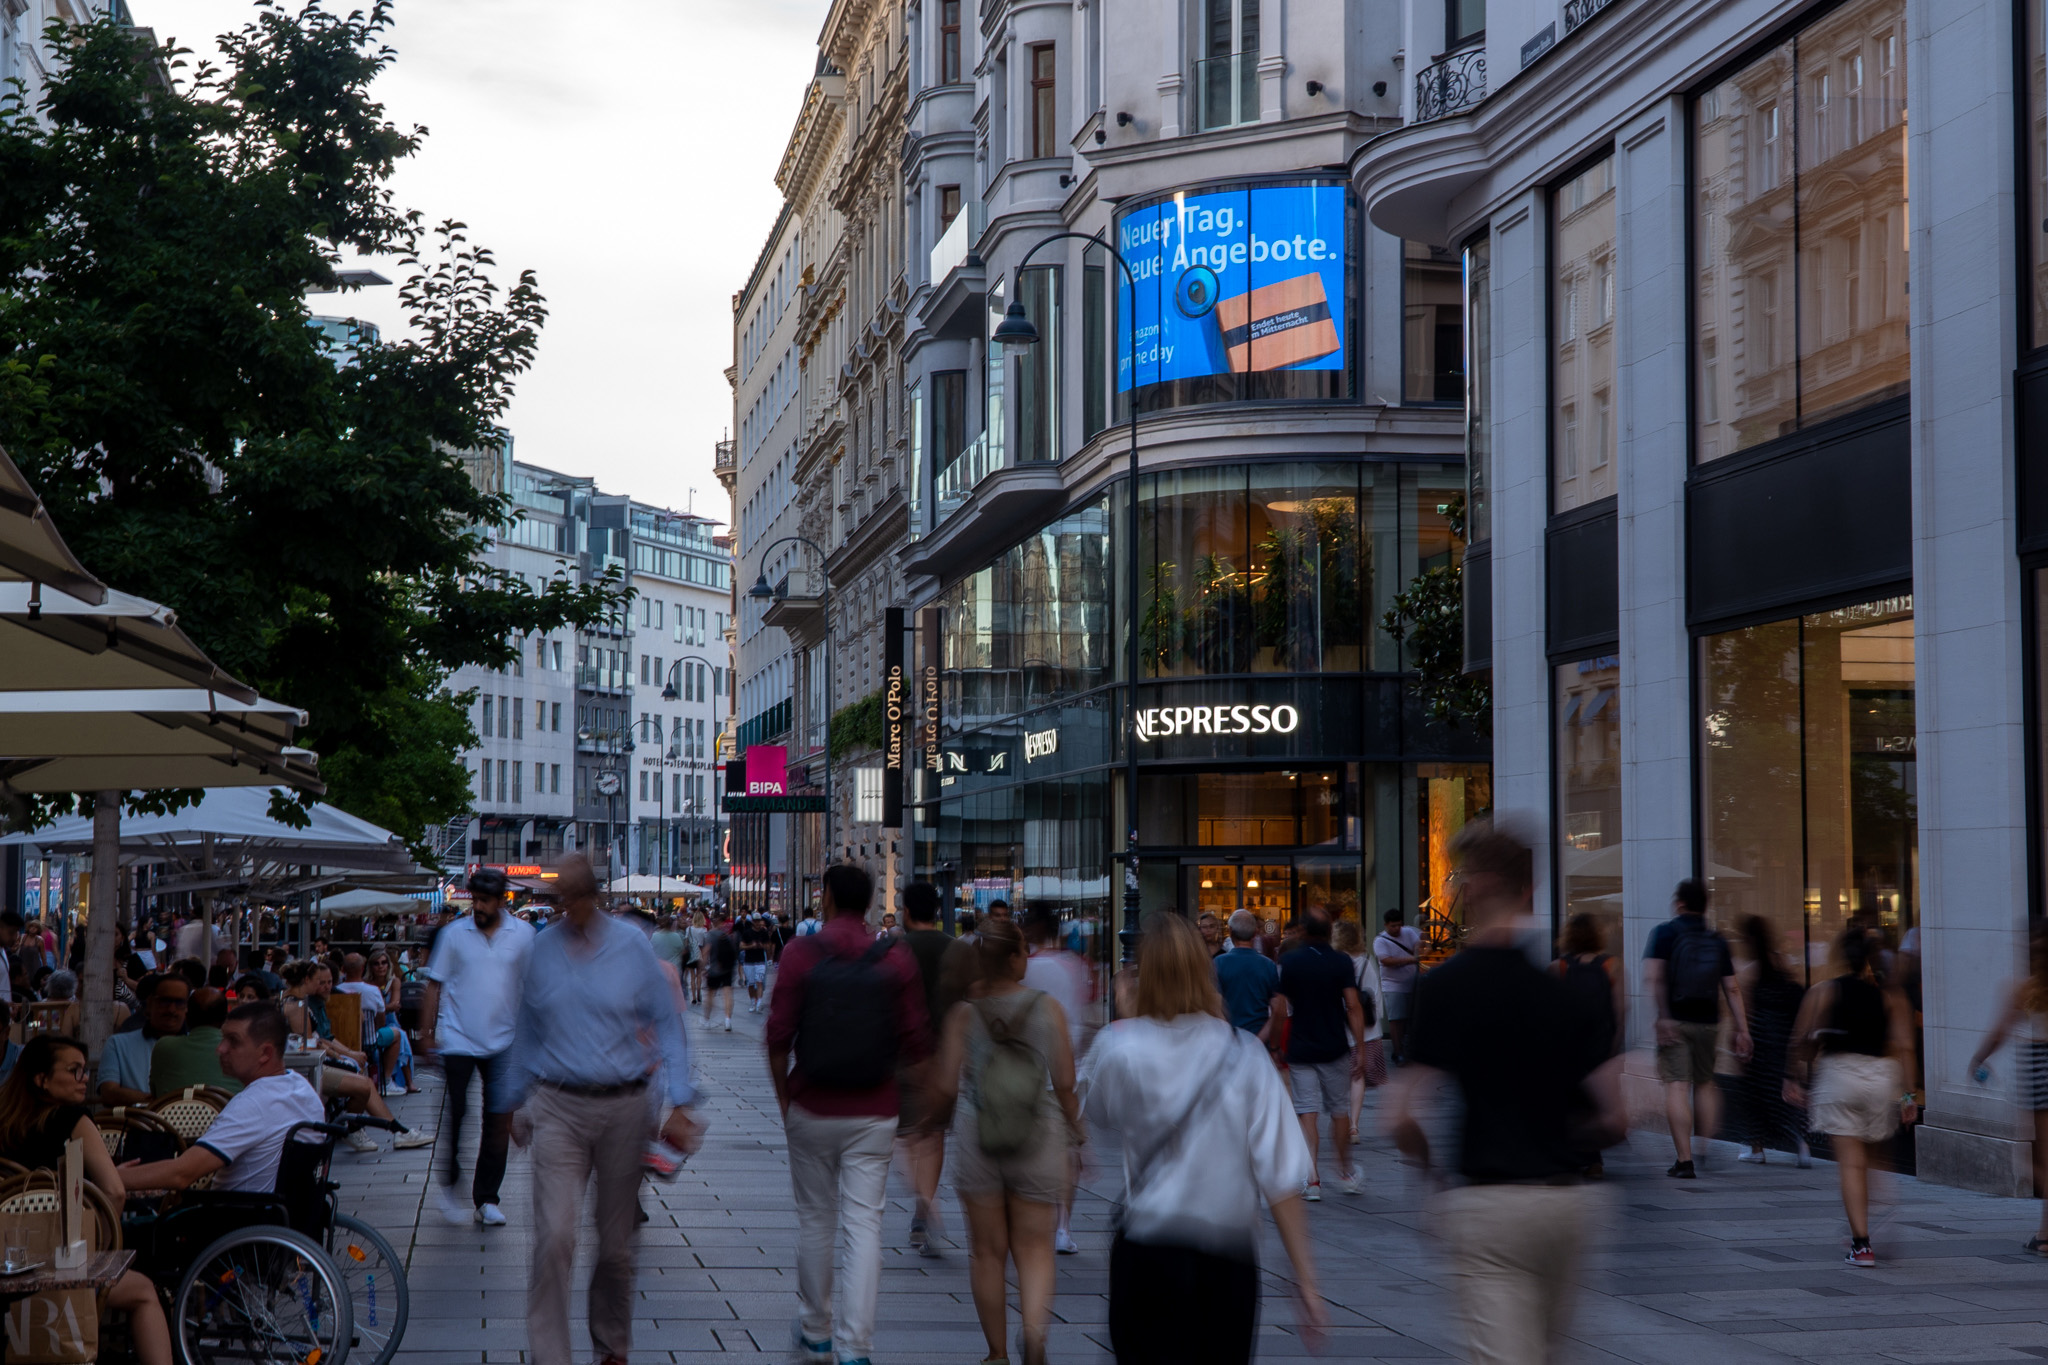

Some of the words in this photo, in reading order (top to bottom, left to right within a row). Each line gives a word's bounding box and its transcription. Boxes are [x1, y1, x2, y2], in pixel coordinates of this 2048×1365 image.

[1121, 216, 1175, 253] Neuer
[1184, 205, 1244, 237] Tag.
[1171, 234, 1337, 274] Angebote.
[1251, 318, 1275, 331] Endet
[1275, 311, 1300, 322] heute
[1260, 316, 1308, 336] Mitternacht
[887, 665, 901, 721] O'Polo
[887, 724, 901, 770] Marc
[749, 781, 783, 794] BIPA
[727, 798, 827, 812] SALAMANDER
